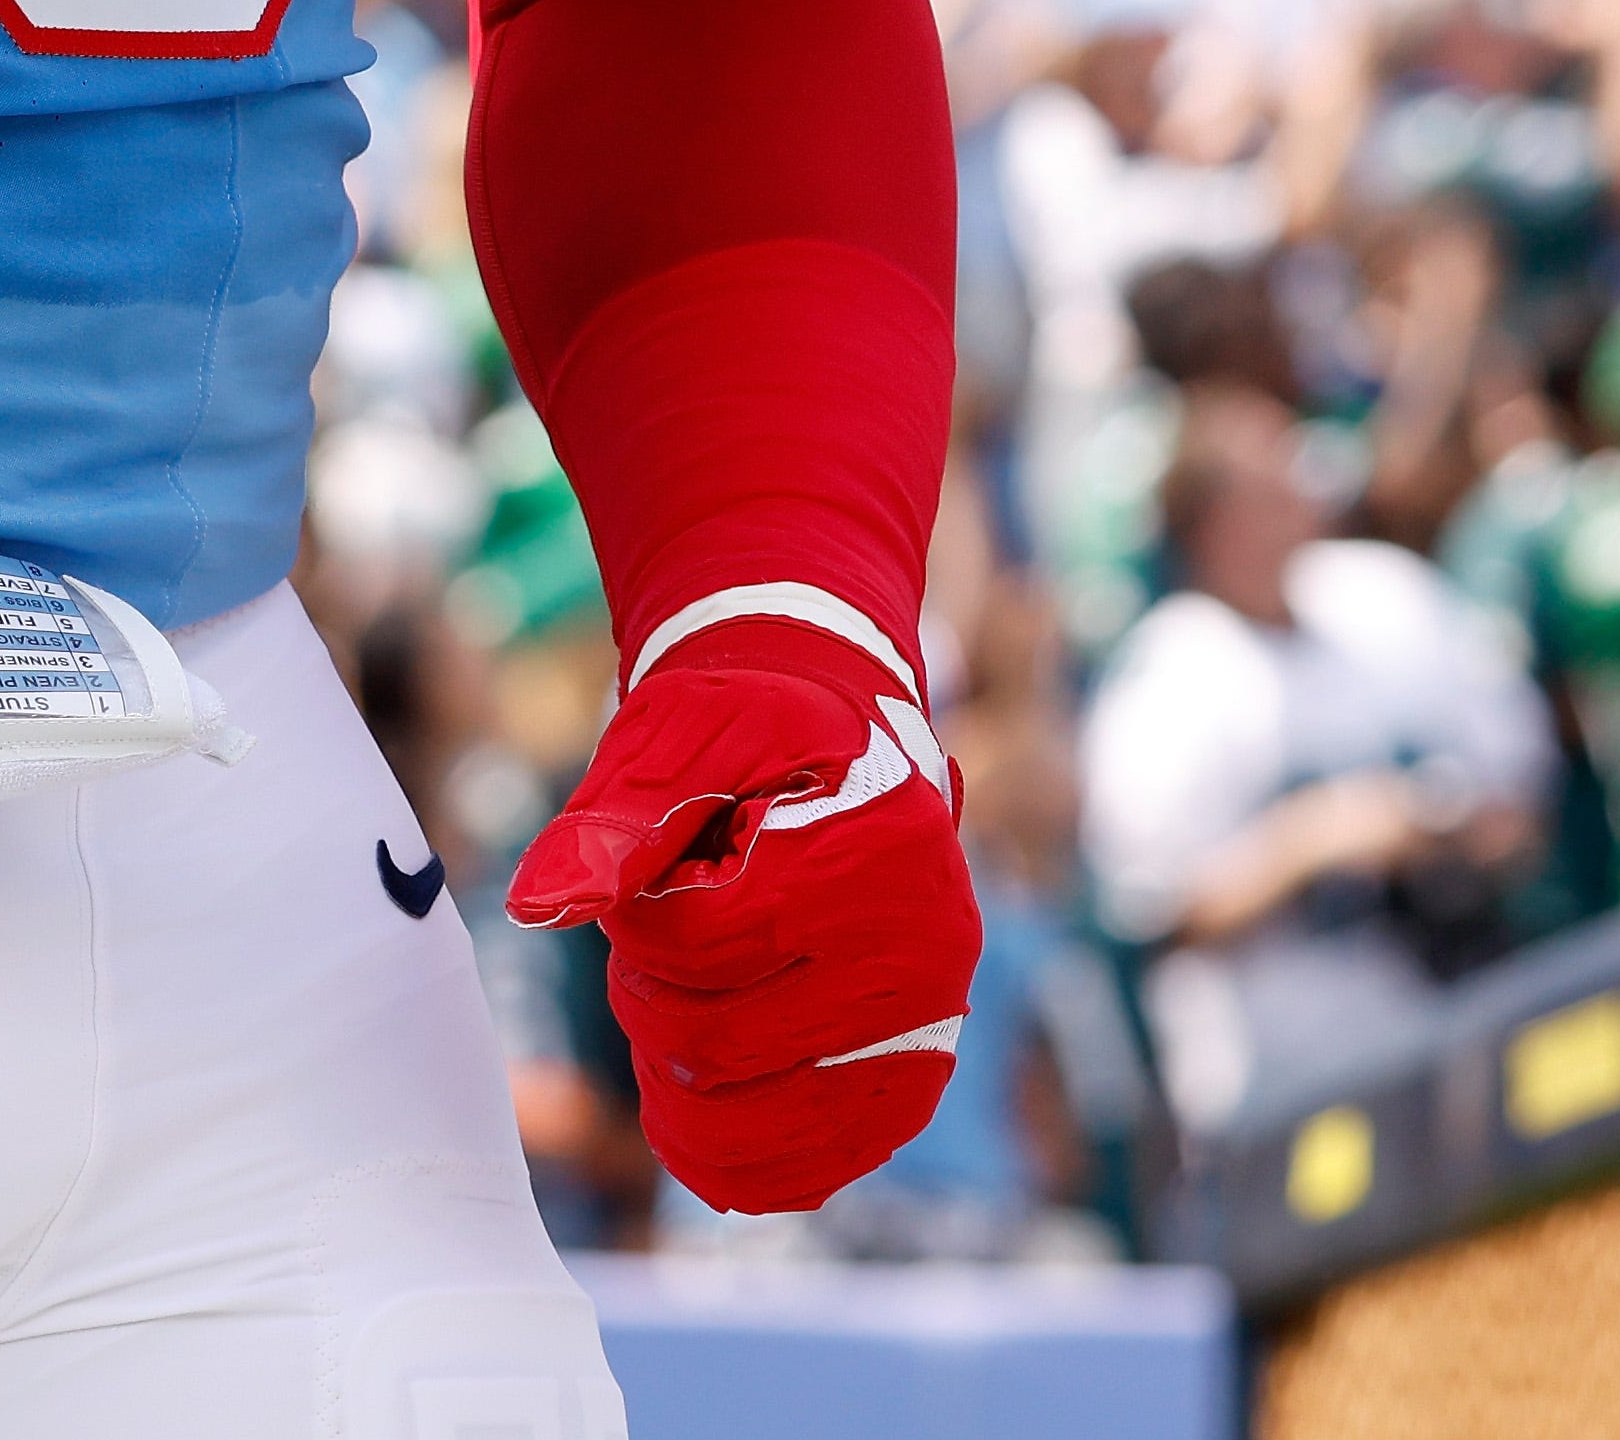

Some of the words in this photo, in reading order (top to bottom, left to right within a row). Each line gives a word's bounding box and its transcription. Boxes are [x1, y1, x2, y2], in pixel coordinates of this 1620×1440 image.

[44, 585, 55, 594] 7
[50, 601, 64, 611] 6
[60, 619, 73, 629] 5
[69, 637, 82, 648] 4
[79, 656, 93, 668] 3
[23, 676, 78, 687] EVEN
[88, 675, 102, 687] 2
[99, 696, 109, 713] 1
